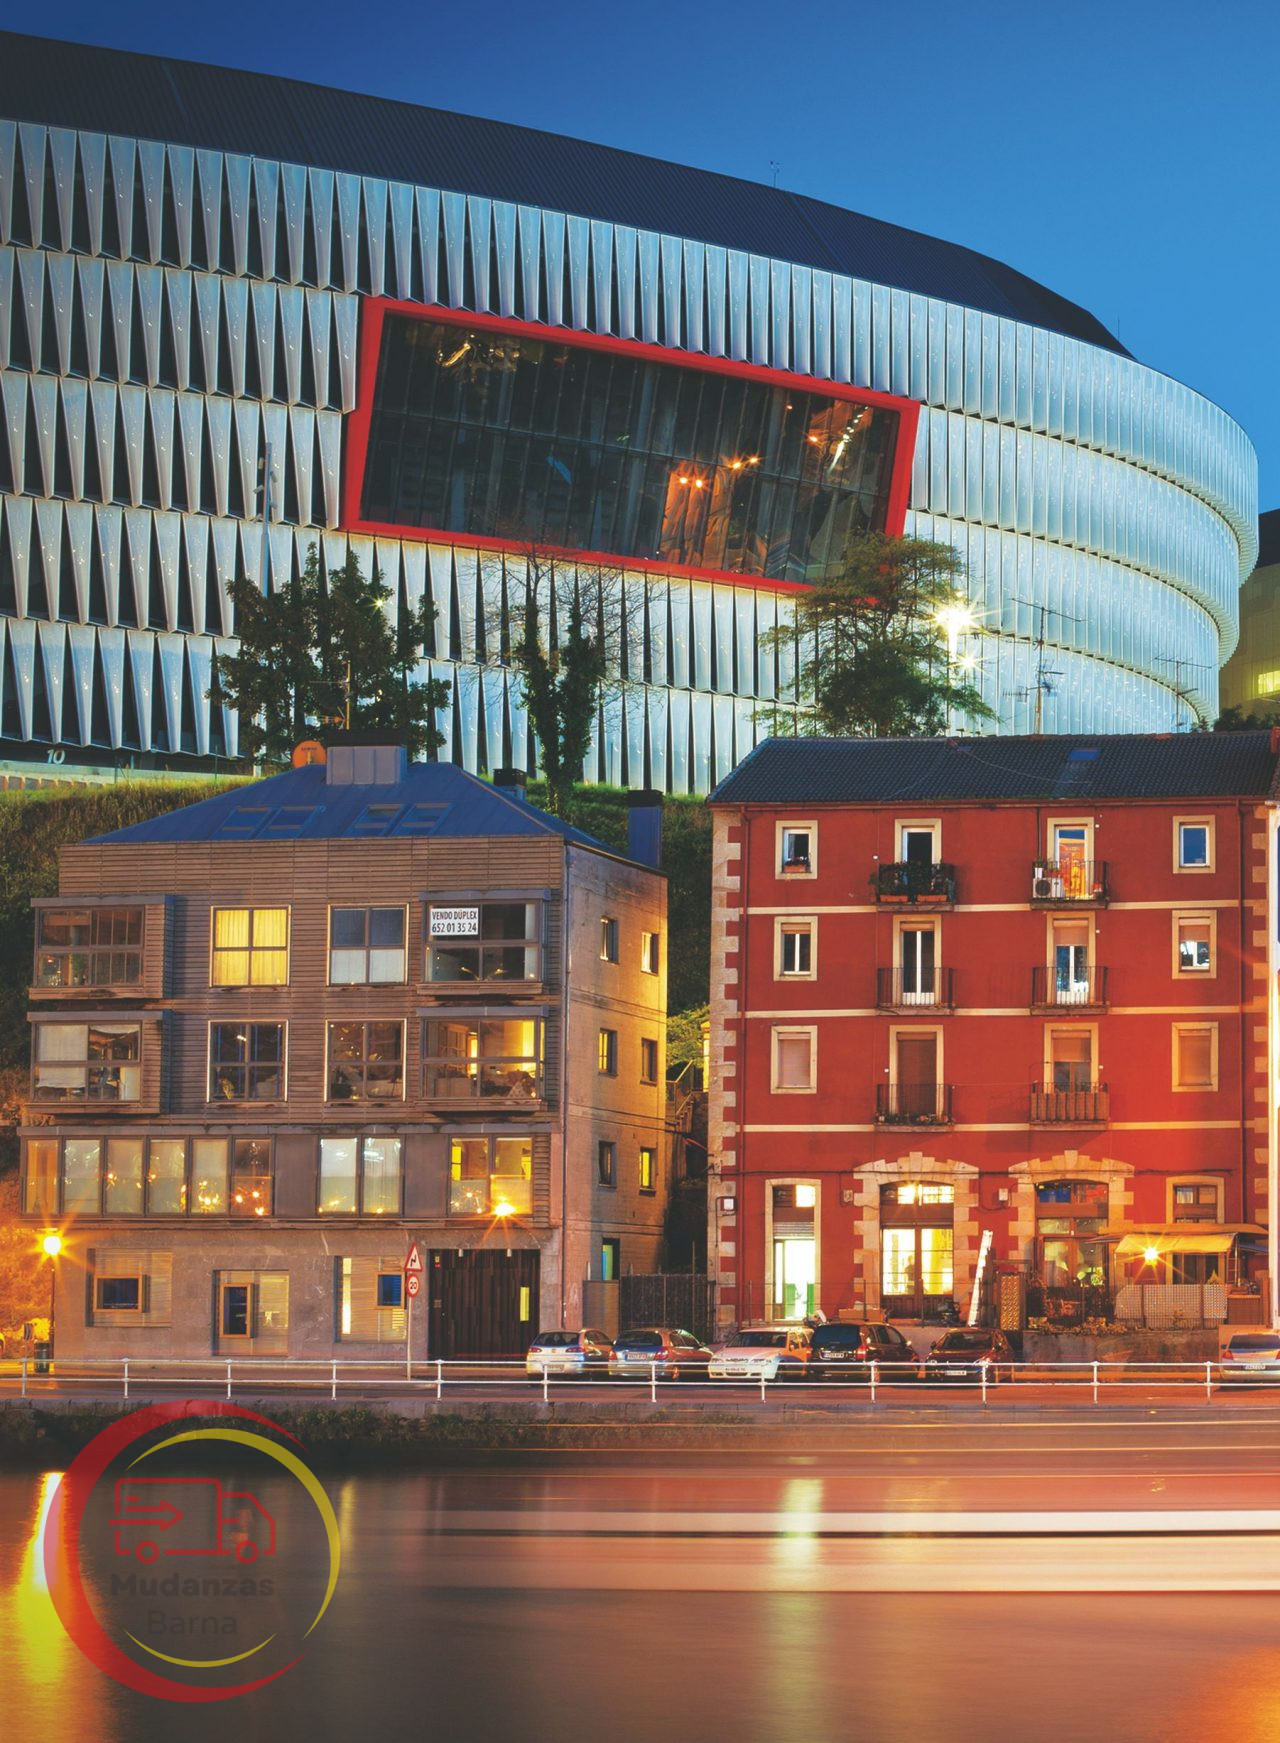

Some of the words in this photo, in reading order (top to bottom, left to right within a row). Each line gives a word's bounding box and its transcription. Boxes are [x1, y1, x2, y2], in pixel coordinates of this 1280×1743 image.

[47, 749, 66, 765] 10
[432, 911, 452, 920] VENDO
[431, 922, 446, 933] 652
[447, 922, 455, 933] 01
[457, 922, 466, 933] 35
[467, 922, 477, 933] 24
[409, 1281, 418, 1290] 20
